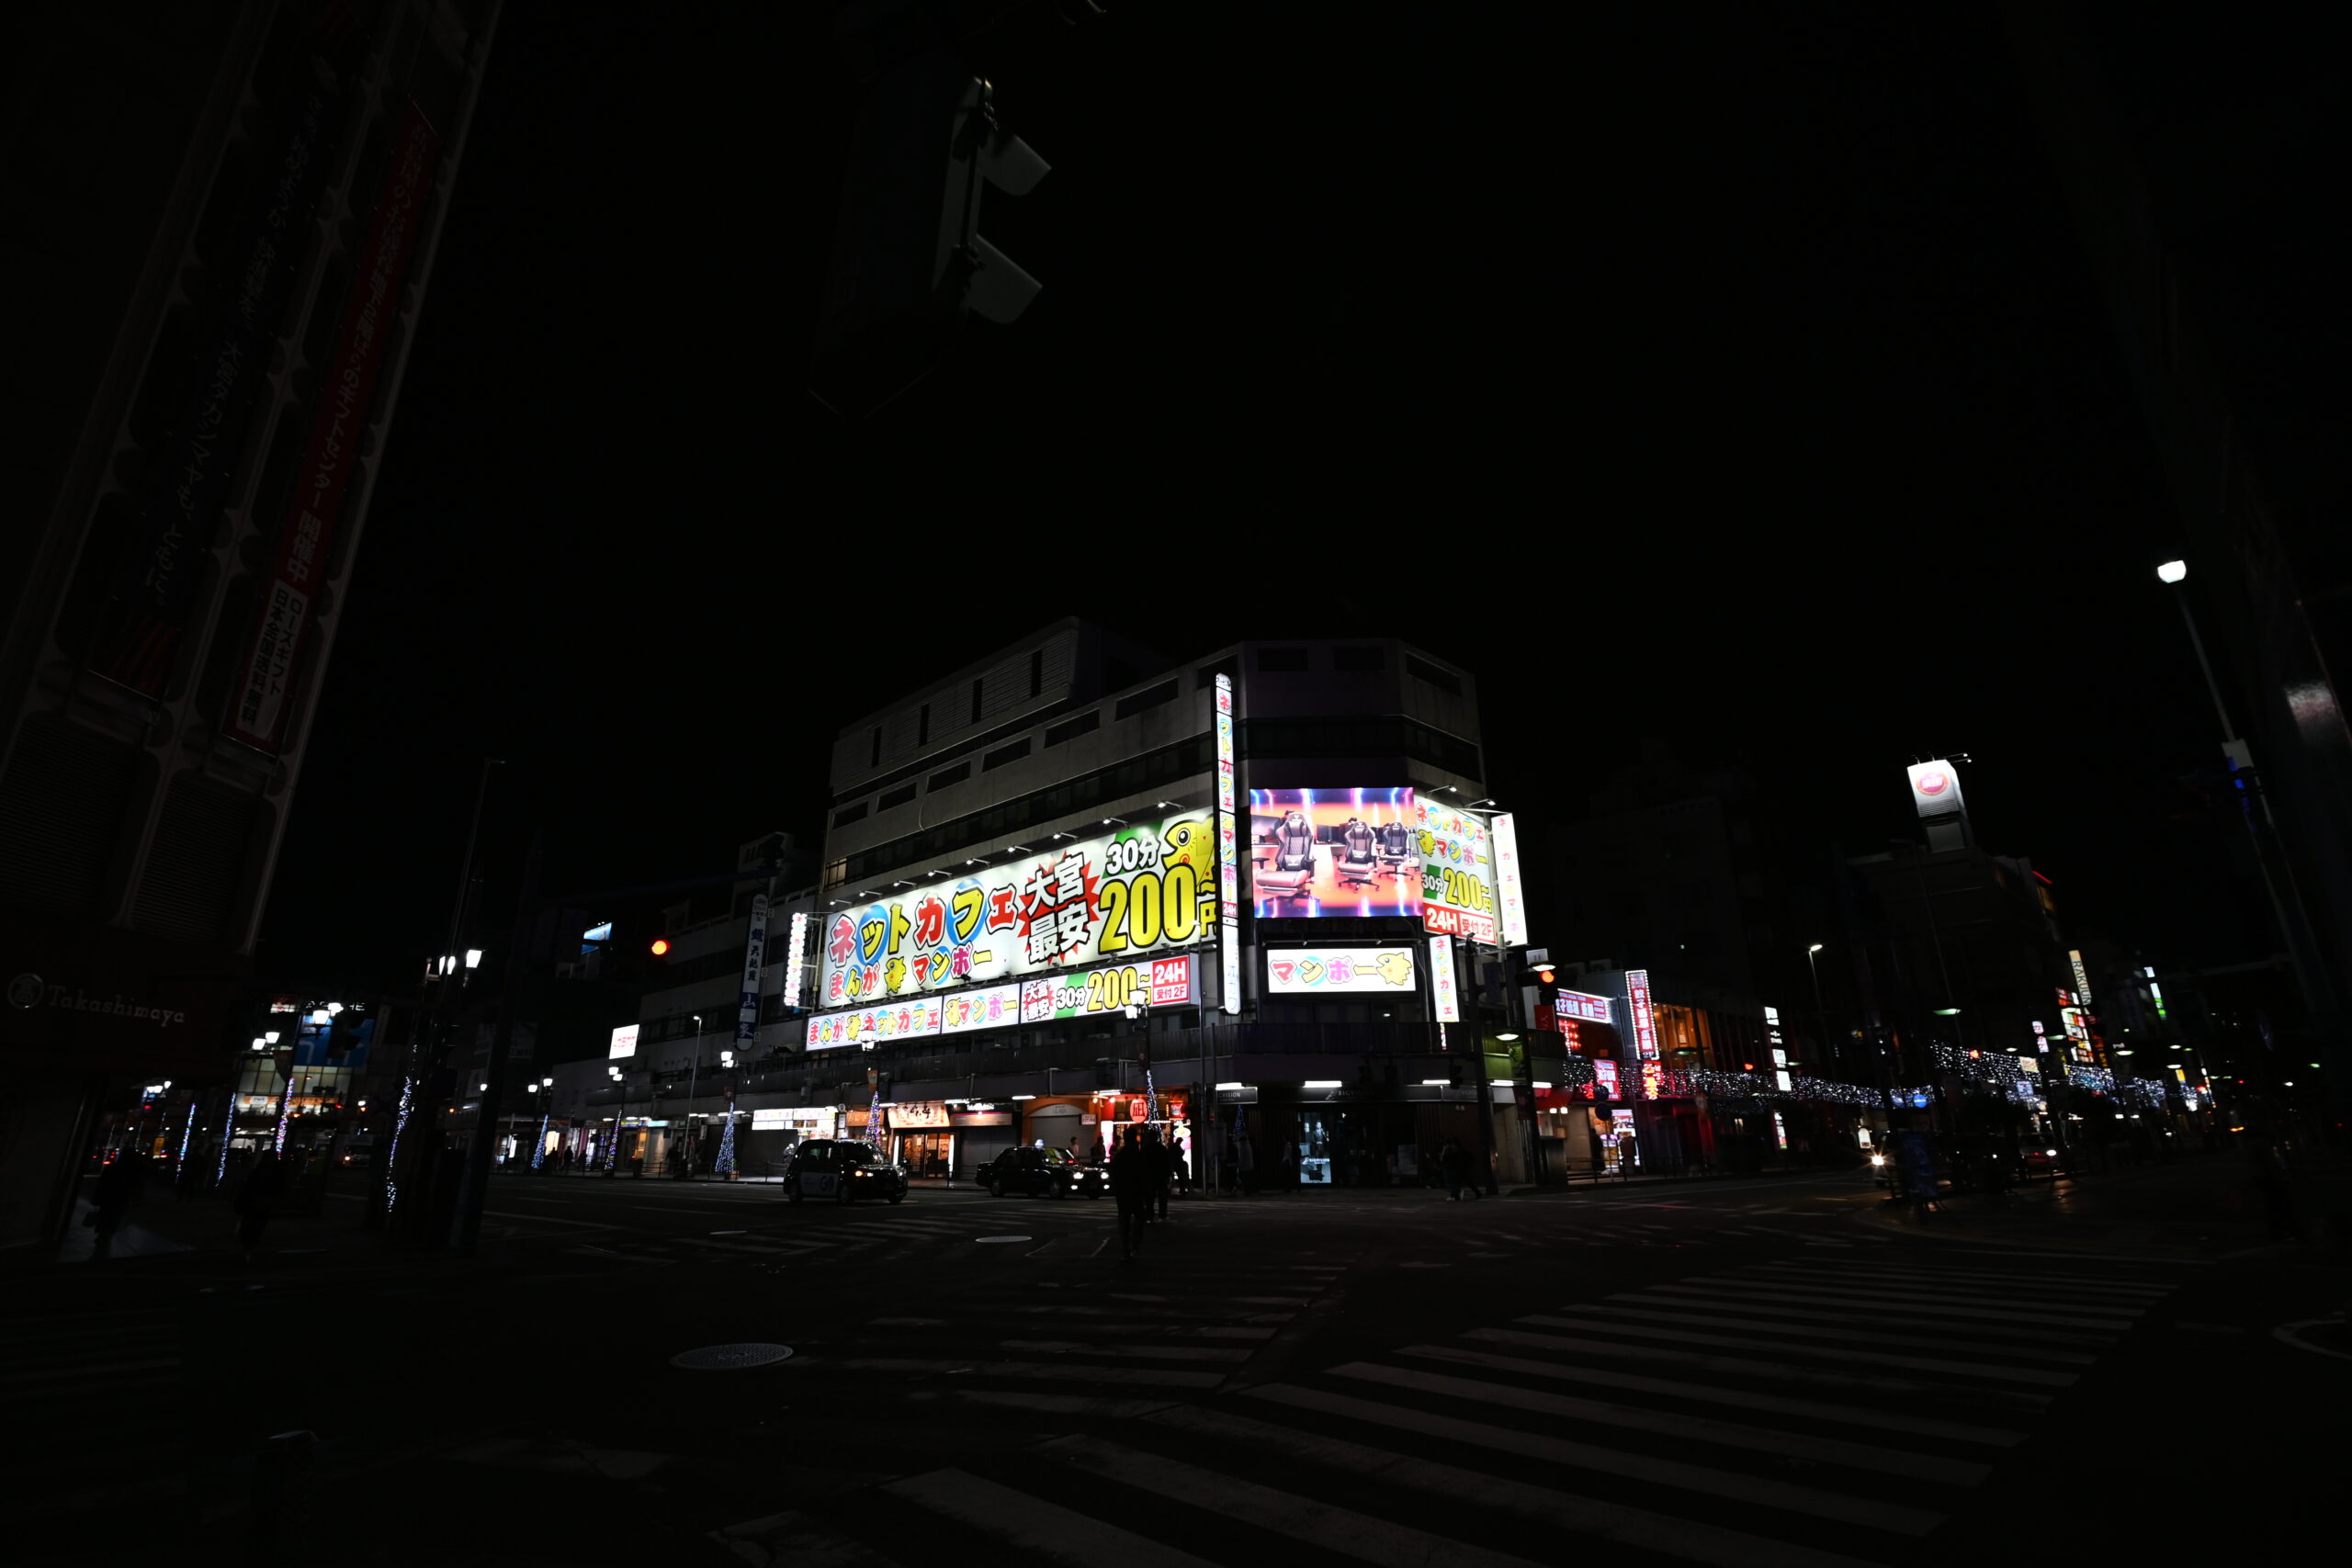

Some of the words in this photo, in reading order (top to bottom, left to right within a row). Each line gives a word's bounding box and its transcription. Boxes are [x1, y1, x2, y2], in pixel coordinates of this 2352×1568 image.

[269, 599, 302, 694] ローズギフト
[1417, 803, 1486, 842] ネットカフェ
[1105, 834, 1161, 876] 30分
[1223, 829, 1236, 901] マンボー
[1435, 837, 1488, 866] マンボー
[1024, 852, 1087, 916] 大宮
[1421, 873, 1445, 894] 30分
[829, 884, 1018, 967] ネットカフェ
[1029, 904, 1091, 964] 最安
[1426, 907, 1458, 932] 24H
[1462, 919, 1479, 935] 受付
[1480, 921, 1493, 937] 2F
[829, 962, 879, 1000] まんが
[913, 944, 992, 984] マンボー
[1154, 961, 1186, 982] 24H
[1270, 955, 1377, 985] マンボー
[1435, 939, 1453, 1014] ネットカフェ
[48, 985, 185, 1027] Takashimaya
[1024, 980, 1050, 1001] 大宮
[1026, 998, 1051, 1021] 最安
[1056, 985, 1087, 1010] 30分
[1156, 987, 1173, 1000] 受付
[1174, 986, 1186, 998] 2F
[808, 1019, 844, 1046] まんが
[864, 1003, 940, 1033] ネットカフェ
[957, 994, 1018, 1021] マンボー
